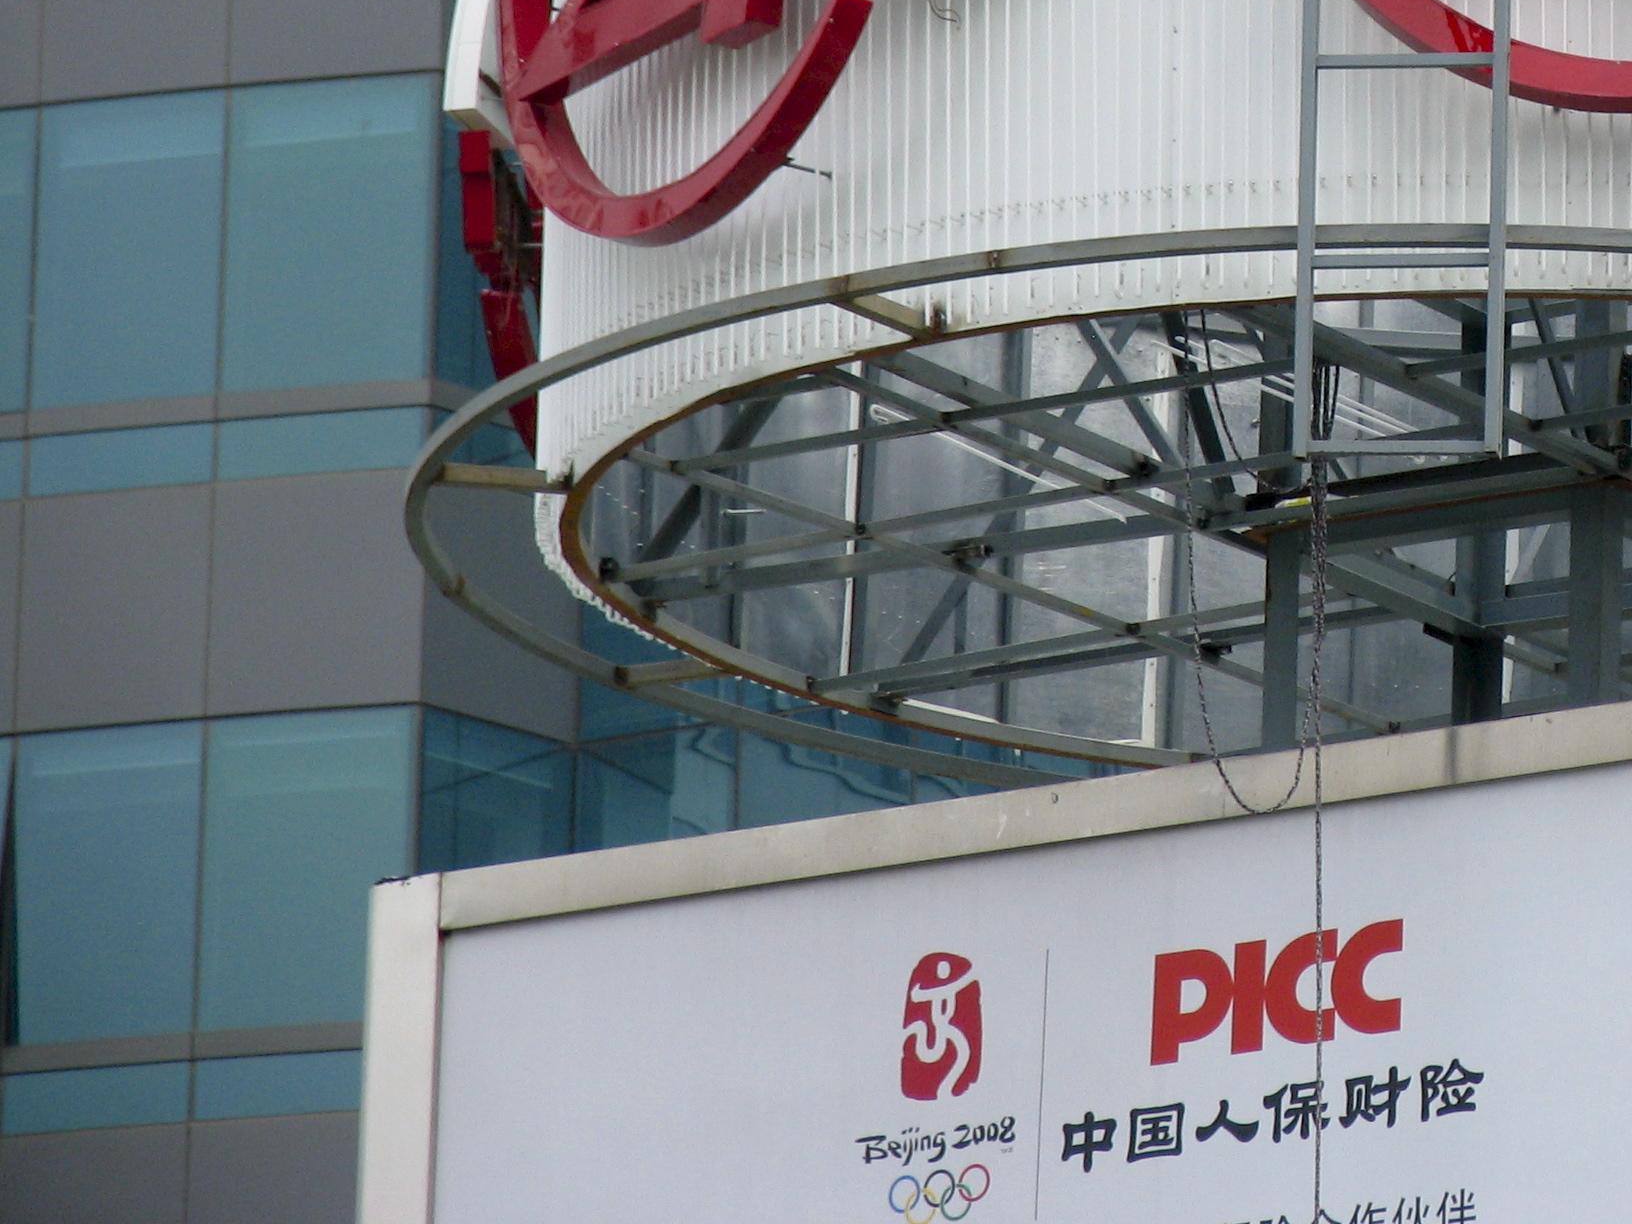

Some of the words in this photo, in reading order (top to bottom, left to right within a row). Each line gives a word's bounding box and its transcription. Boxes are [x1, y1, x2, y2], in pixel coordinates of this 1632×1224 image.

[1150, 918, 1404, 1065] PICC
[855, 1127, 947, 1166] Beijing
[951, 1116, 1016, 1149] 2008
[1061, 1058, 1485, 1173] 中国人保财险
